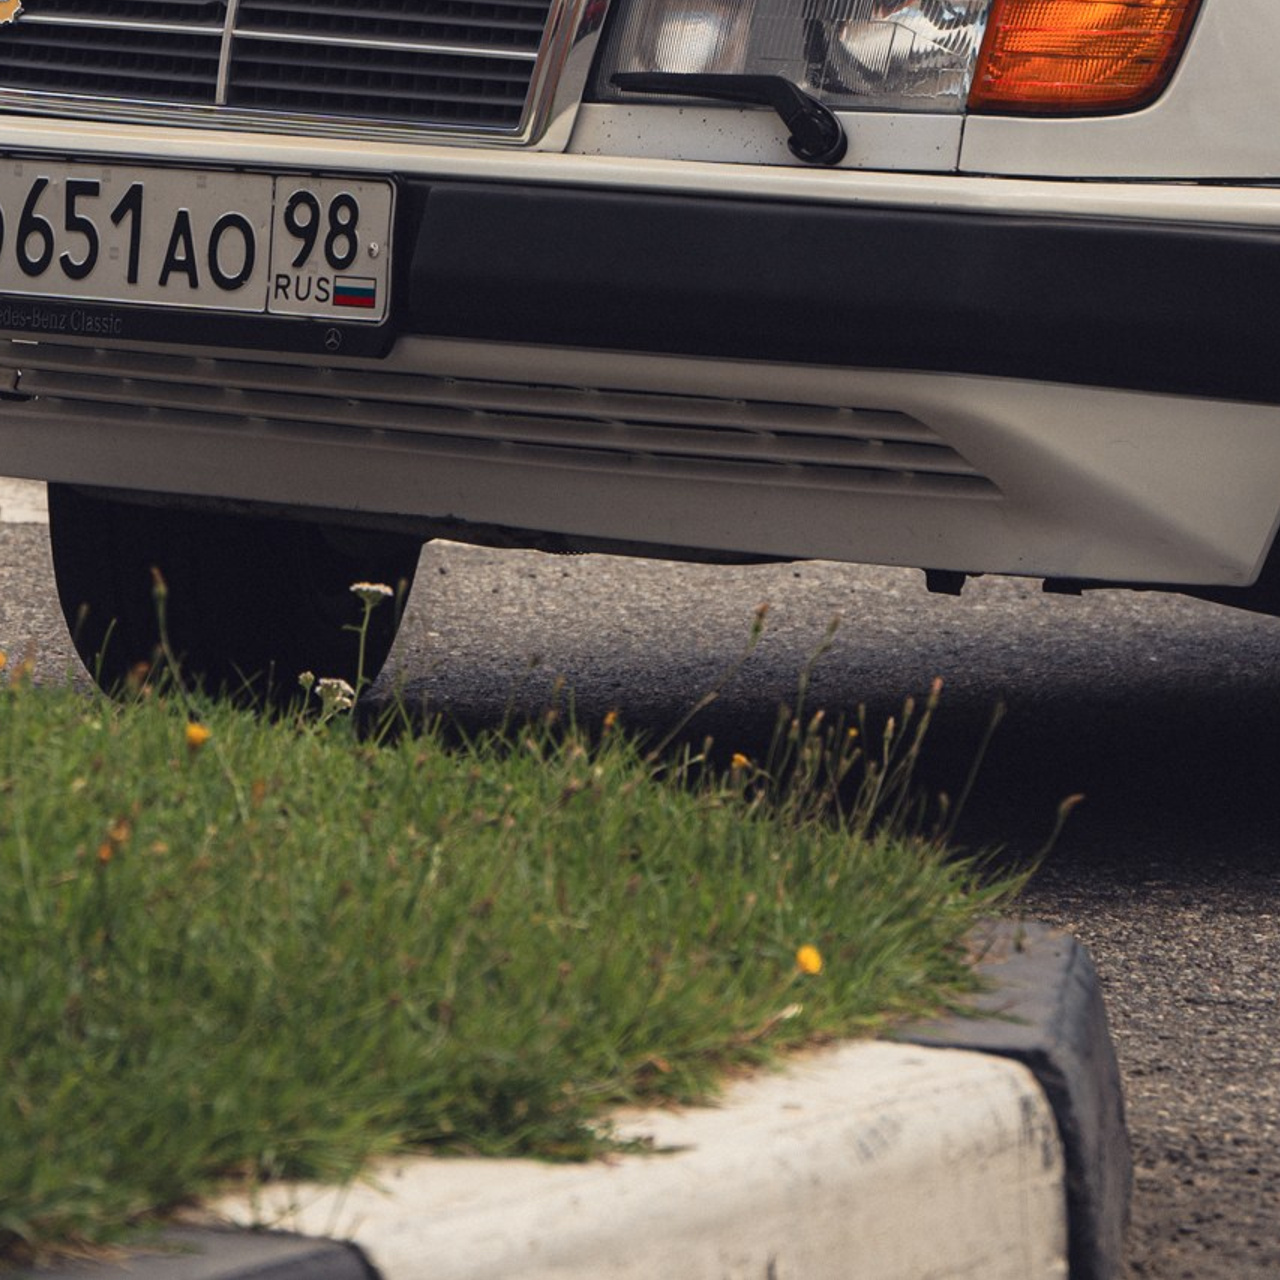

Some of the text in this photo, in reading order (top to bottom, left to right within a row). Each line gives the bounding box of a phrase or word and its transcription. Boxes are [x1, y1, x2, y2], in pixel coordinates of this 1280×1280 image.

[283, 189, 360, 271] 98
[273, 273, 331, 303] RUS
[69, 307, 123, 334] Classic
